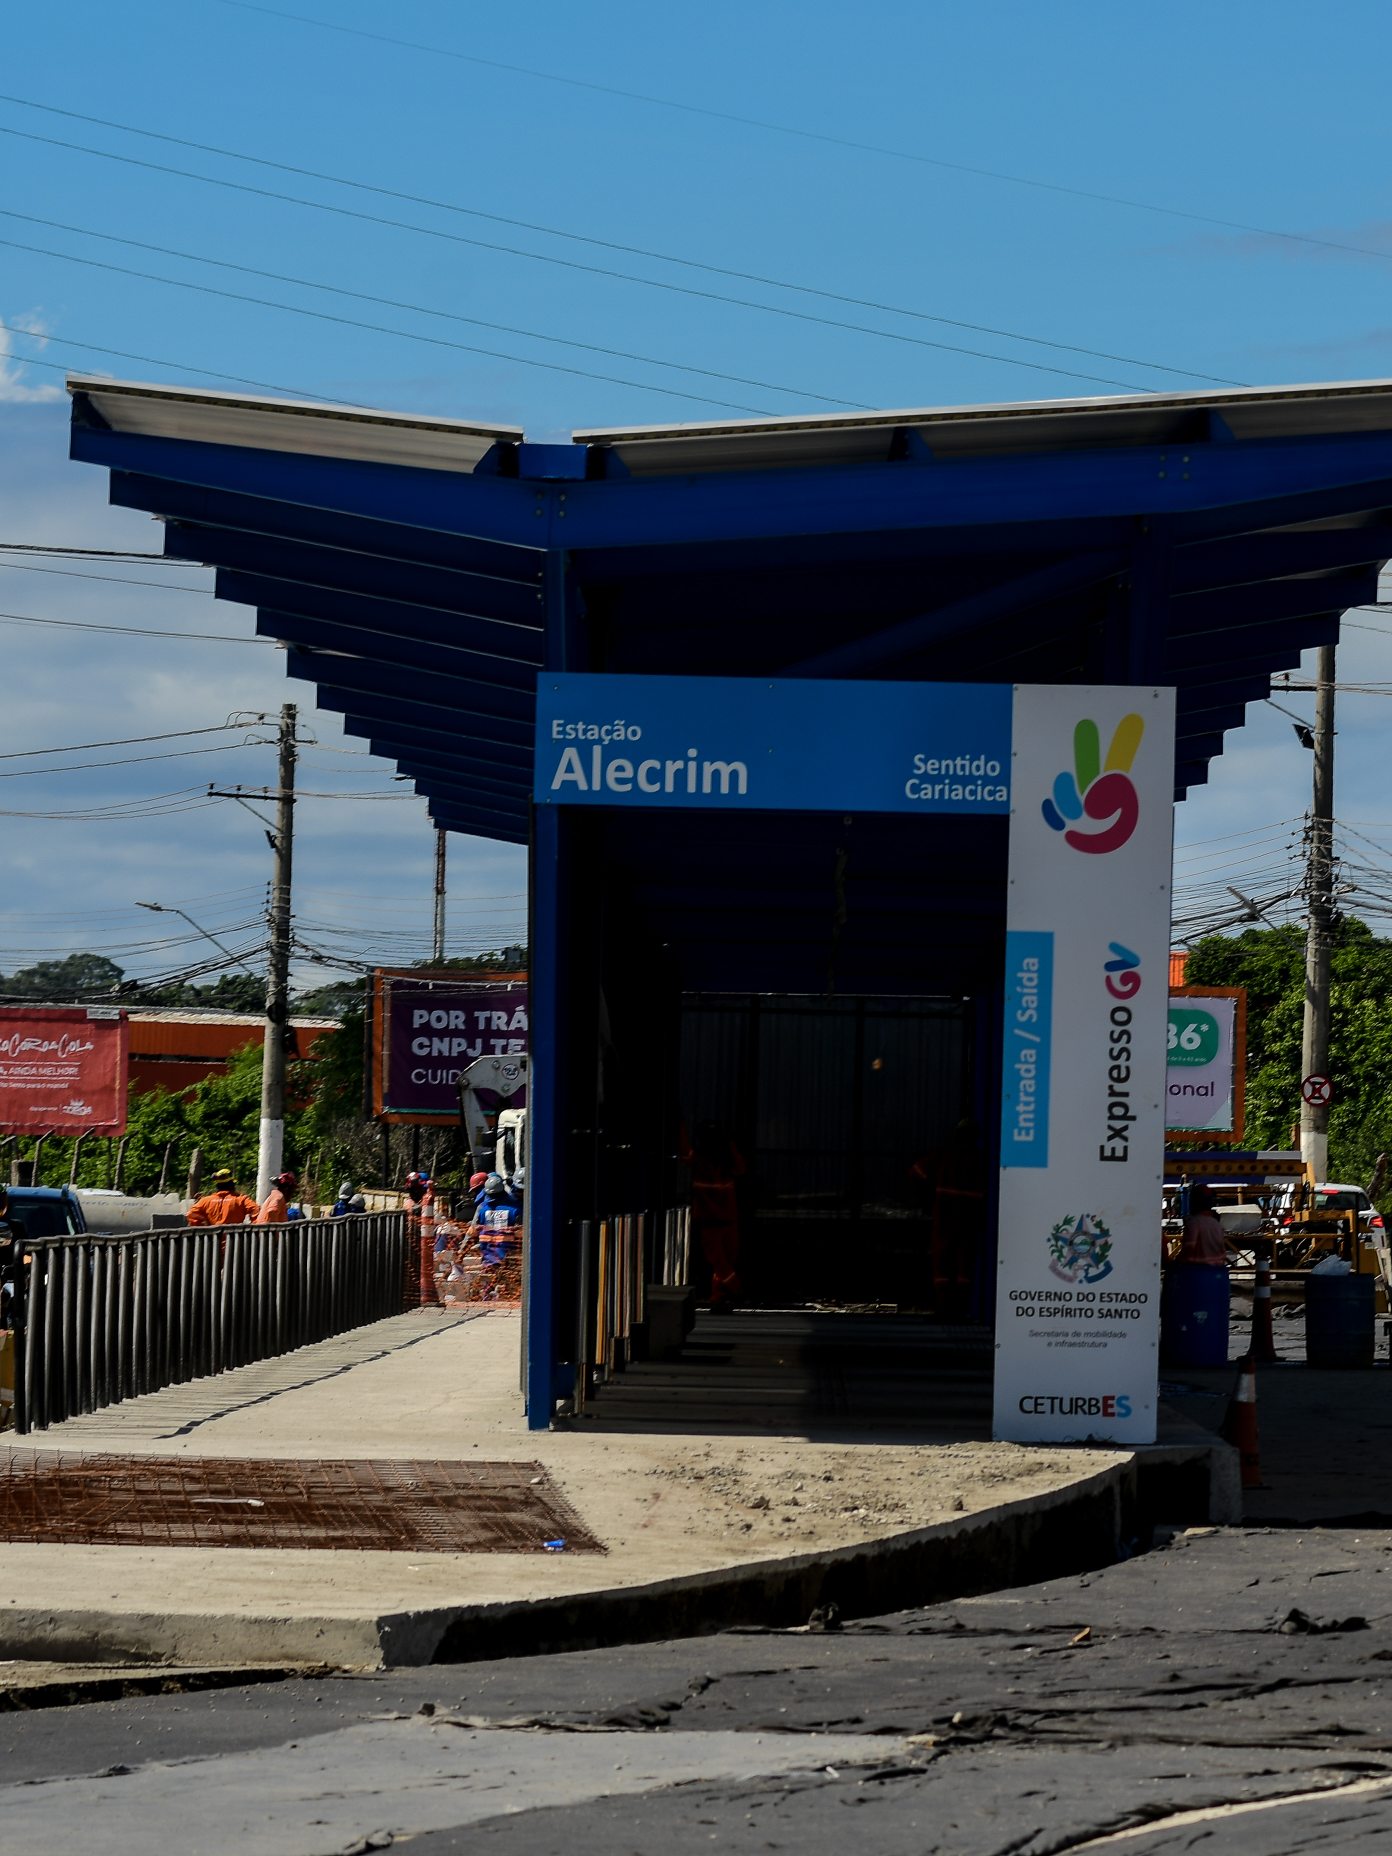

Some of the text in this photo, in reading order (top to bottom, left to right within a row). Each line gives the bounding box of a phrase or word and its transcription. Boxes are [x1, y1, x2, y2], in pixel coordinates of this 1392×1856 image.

[552, 719, 642, 745] Estação
[550, 744, 748, 795] Alecrim
[912, 753, 1001, 777] Sentido
[904, 778, 1008, 802] Cariacica
[1015, 956, 1039, 1023] Saída
[412, 1005, 528, 1031] POR TRÁ
[411, 1036, 483, 1058] CNPJ
[1013, 1047, 1037, 1142] Entrada
[1099, 1005, 1137, 1162] Expresso
[1008, 1289, 1148, 1304] GOVERNO DO ESTADO
[1015, 1305, 1141, 1320] DO ESPÍRITO SANTO
[1028, 1329, 1127, 1340] Secretaria de mobilidade
[1054, 1339, 1108, 1349] infraestrutura
[1018, 1395, 1133, 1418] CETURBES
